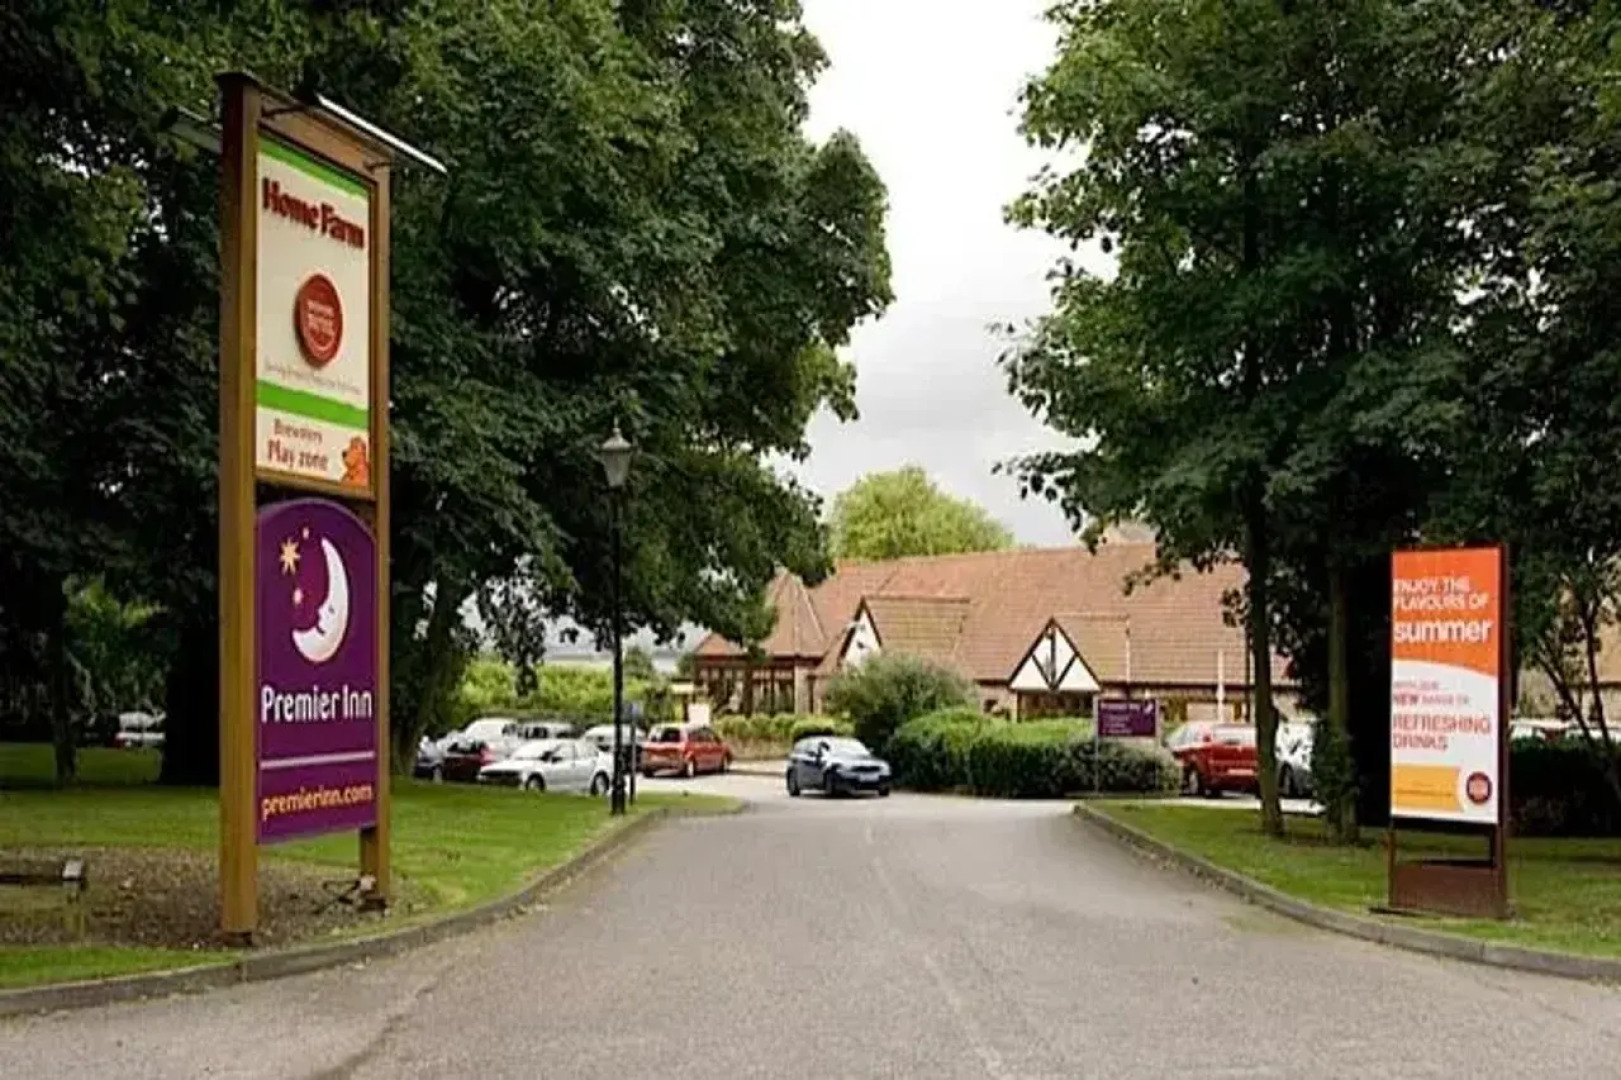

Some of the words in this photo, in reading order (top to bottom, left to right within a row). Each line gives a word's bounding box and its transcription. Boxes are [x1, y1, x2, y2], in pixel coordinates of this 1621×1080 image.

[268, 440, 294, 468] Play
[299, 452, 328, 471] zone
[1469, 592, 1489, 610] OF
[1394, 619, 1493, 643] summer
[261, 684, 340, 724] Premier
[343, 684, 373, 719] Inn
[1393, 713, 1492, 735] REFRESHING
[1393, 734, 1449, 751] DRINKS
[261, 784, 373, 822] premierinn.com
